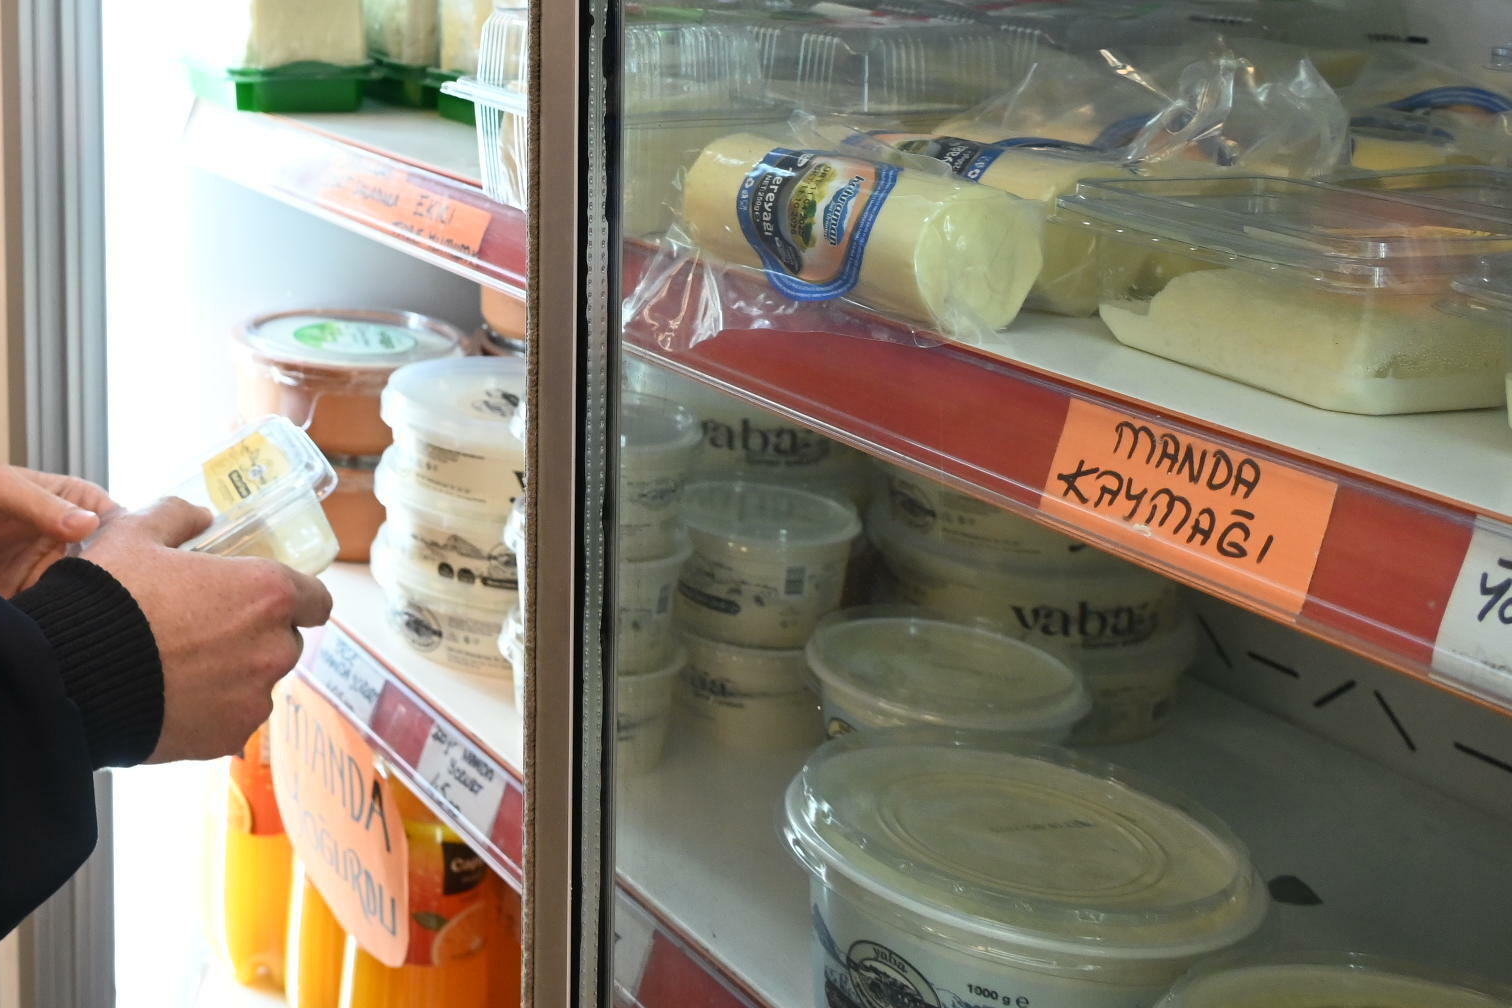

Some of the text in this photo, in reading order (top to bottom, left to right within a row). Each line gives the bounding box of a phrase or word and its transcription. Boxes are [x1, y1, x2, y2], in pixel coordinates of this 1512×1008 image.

[1113, 421, 1261, 499] MANDA
[1056, 459, 1274, 563] KAYMAĞI
[285, 693, 392, 854] MANDA
[967, 983, 999, 1001] 1000
